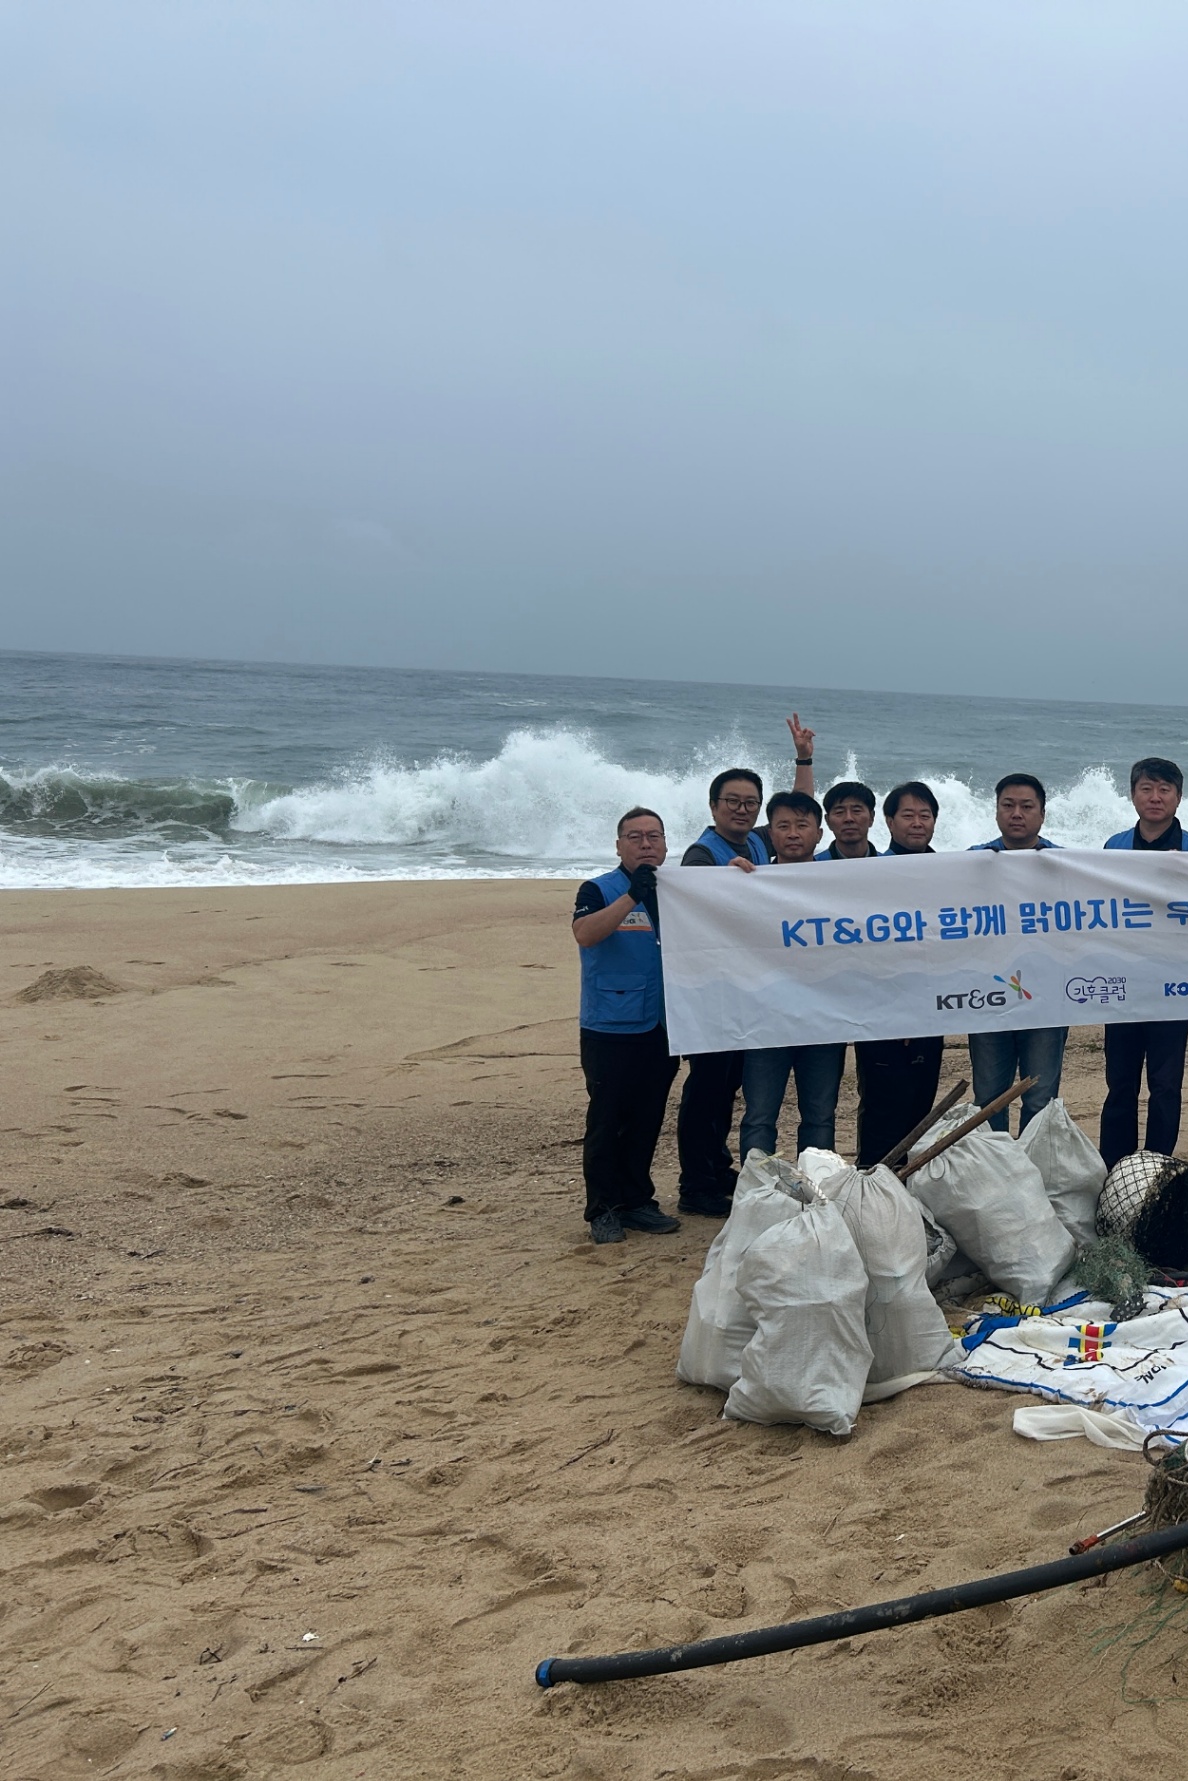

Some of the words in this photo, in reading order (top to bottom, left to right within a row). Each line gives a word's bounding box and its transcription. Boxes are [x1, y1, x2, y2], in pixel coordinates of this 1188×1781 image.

[781, 910, 927, 948] KT&G와
[937, 904, 1006, 940] 함께
[1019, 898, 1154, 934] 맑아지는
[936, 989, 1007, 1011] KT&G
[1073, 984, 1127, 1004] 기후클럽
